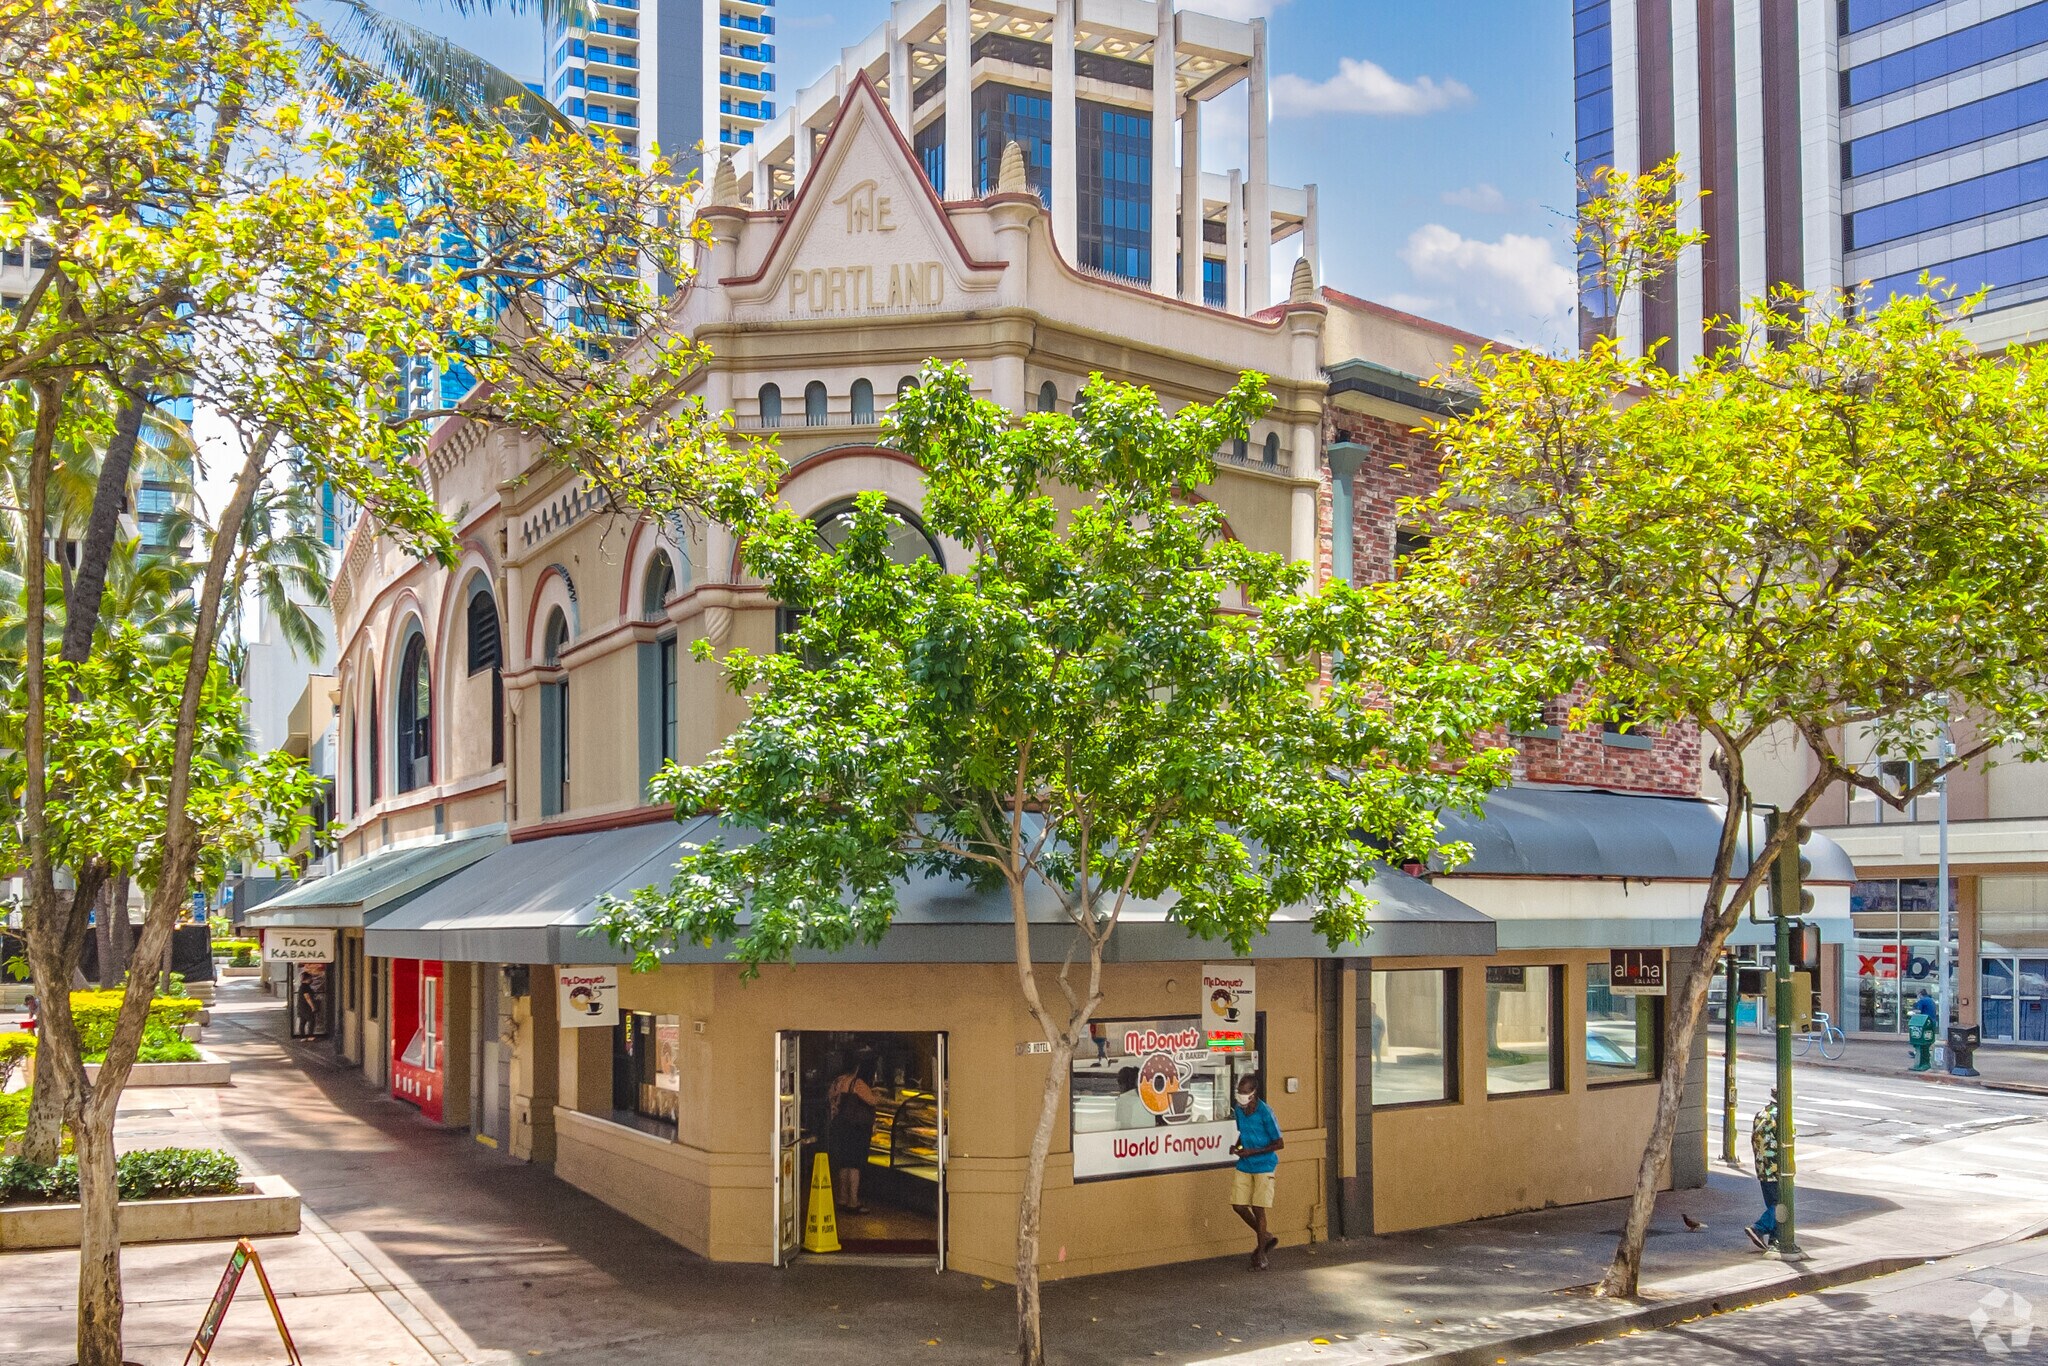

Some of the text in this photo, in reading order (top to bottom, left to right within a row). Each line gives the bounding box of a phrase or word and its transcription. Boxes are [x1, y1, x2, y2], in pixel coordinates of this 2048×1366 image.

[832, 178, 897, 233] THE
[788, 261, 944, 313] PORTLAND
[282, 937, 316, 947] TACO
[270, 948, 327, 959] KABANA
[1185, 1050, 1209, 1060] BAKERY
[1113, 1133, 1222, 1159] World Famous
